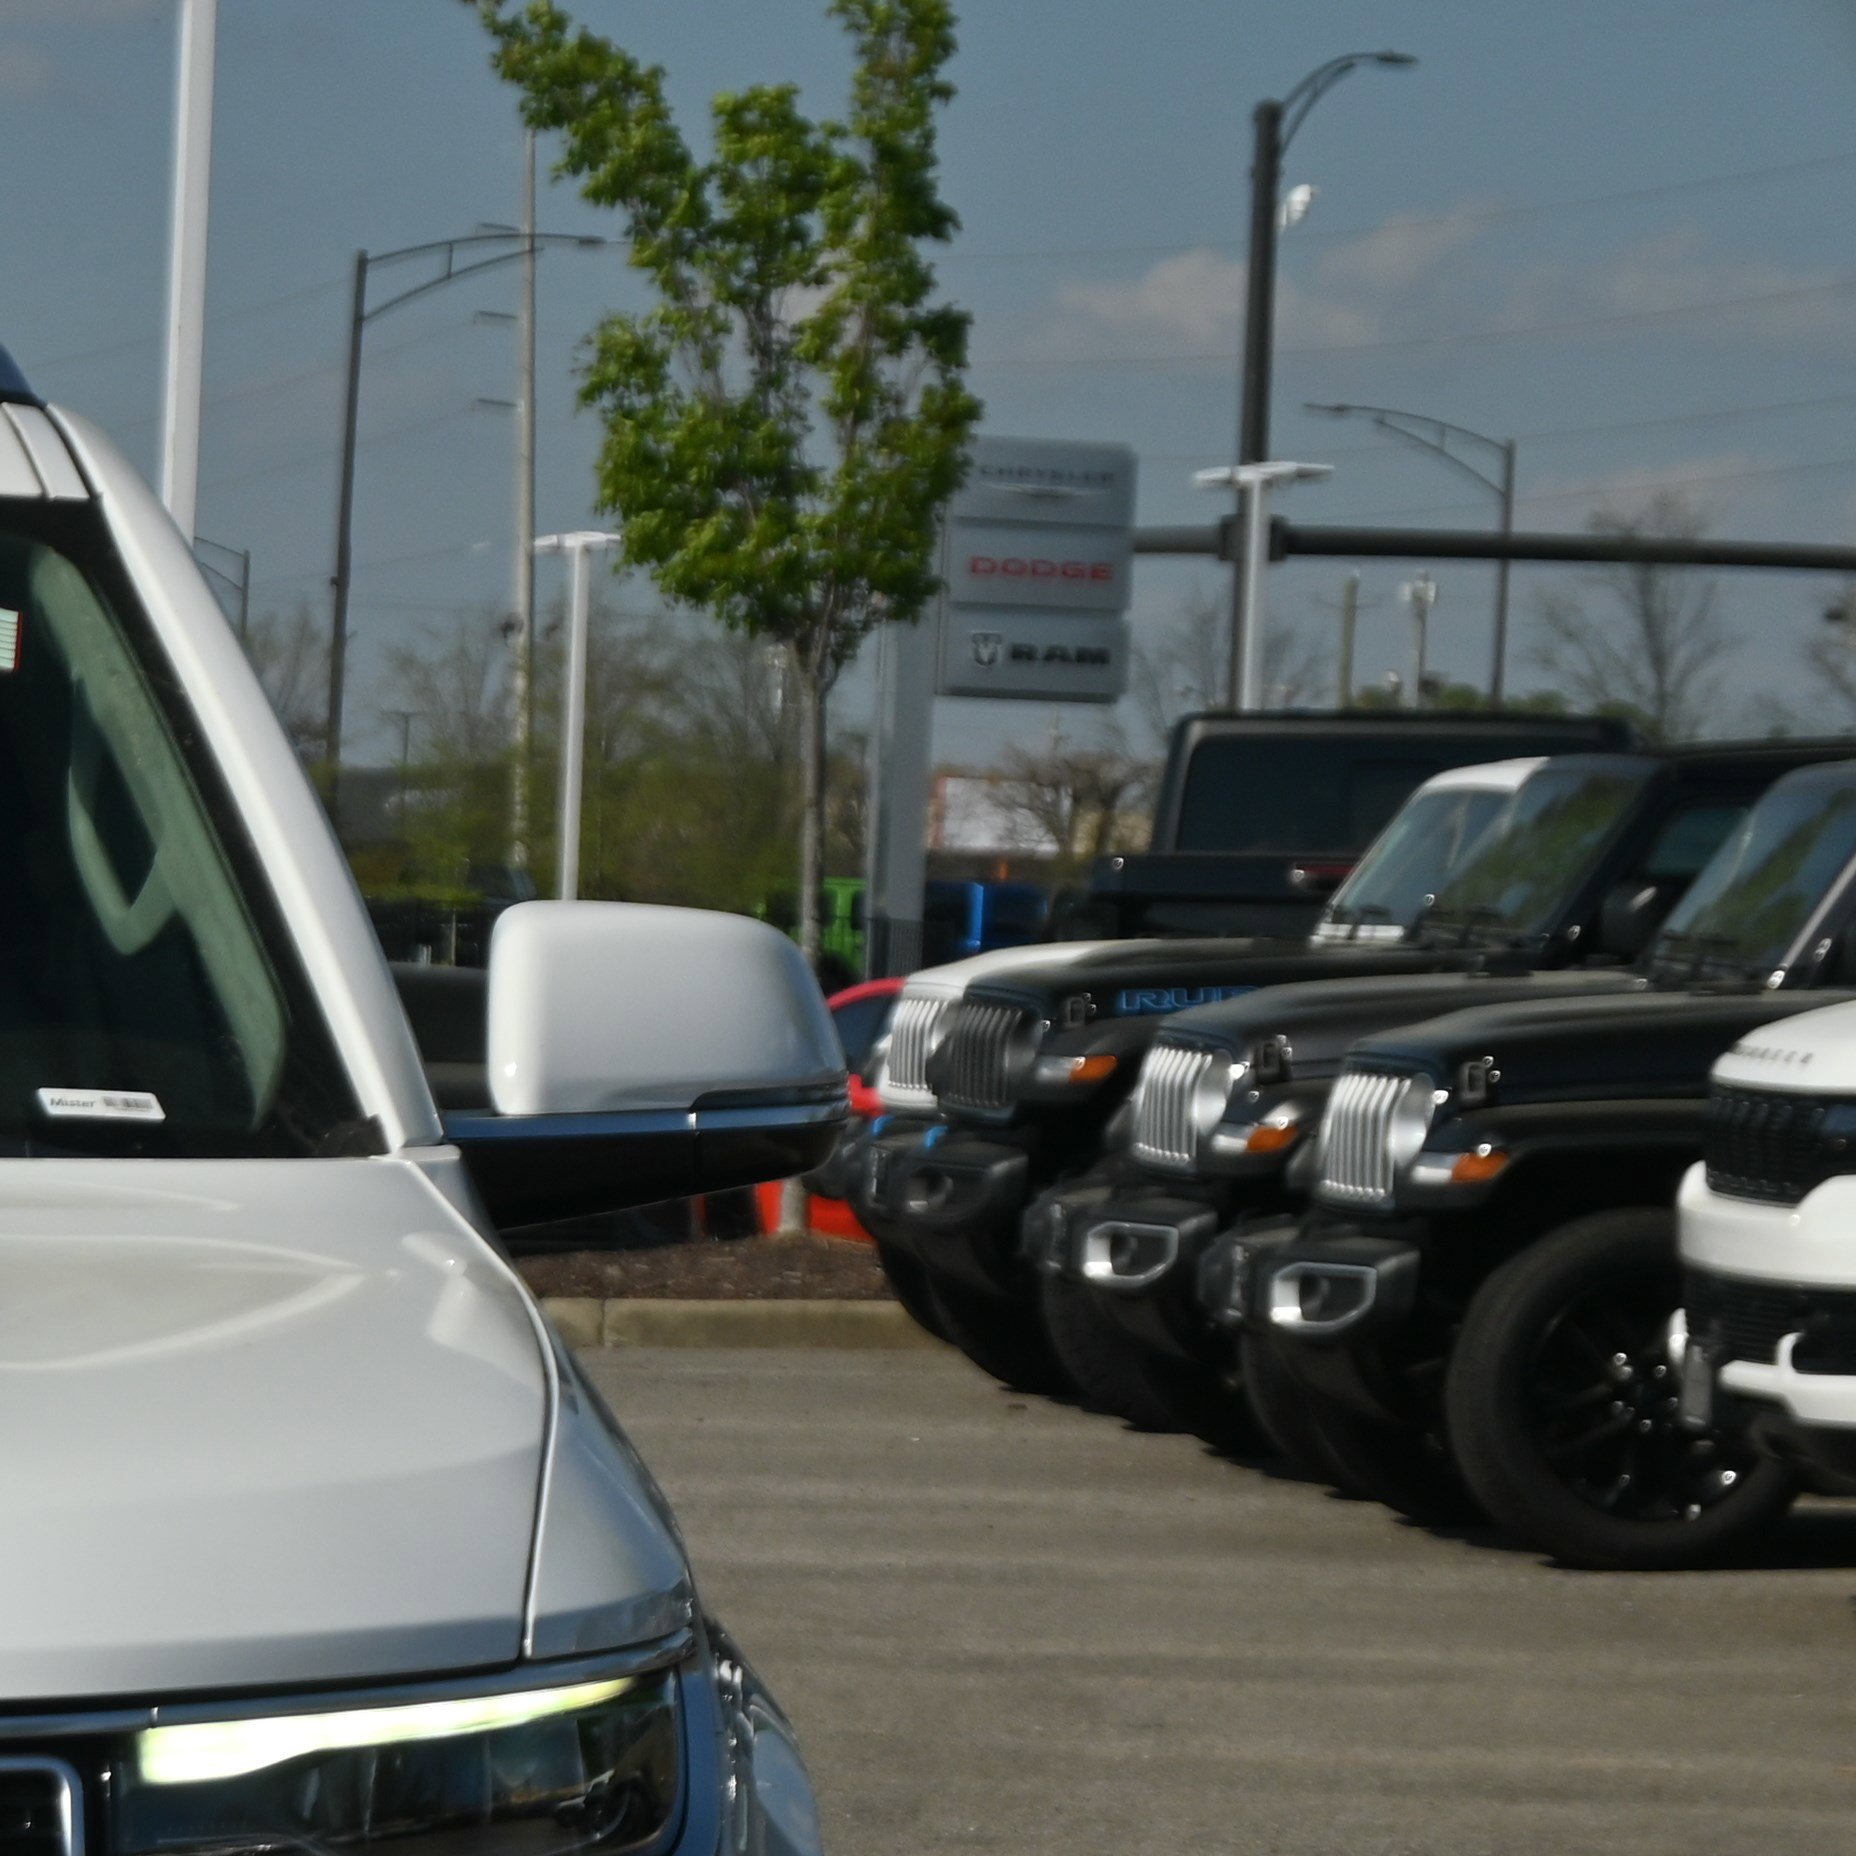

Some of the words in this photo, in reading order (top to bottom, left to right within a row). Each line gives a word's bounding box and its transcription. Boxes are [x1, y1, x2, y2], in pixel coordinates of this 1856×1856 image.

[979, 464, 1116, 482] CHRYSLER
[969, 555, 1114, 581] DODGE
[1010, 642, 1111, 666] RAM
